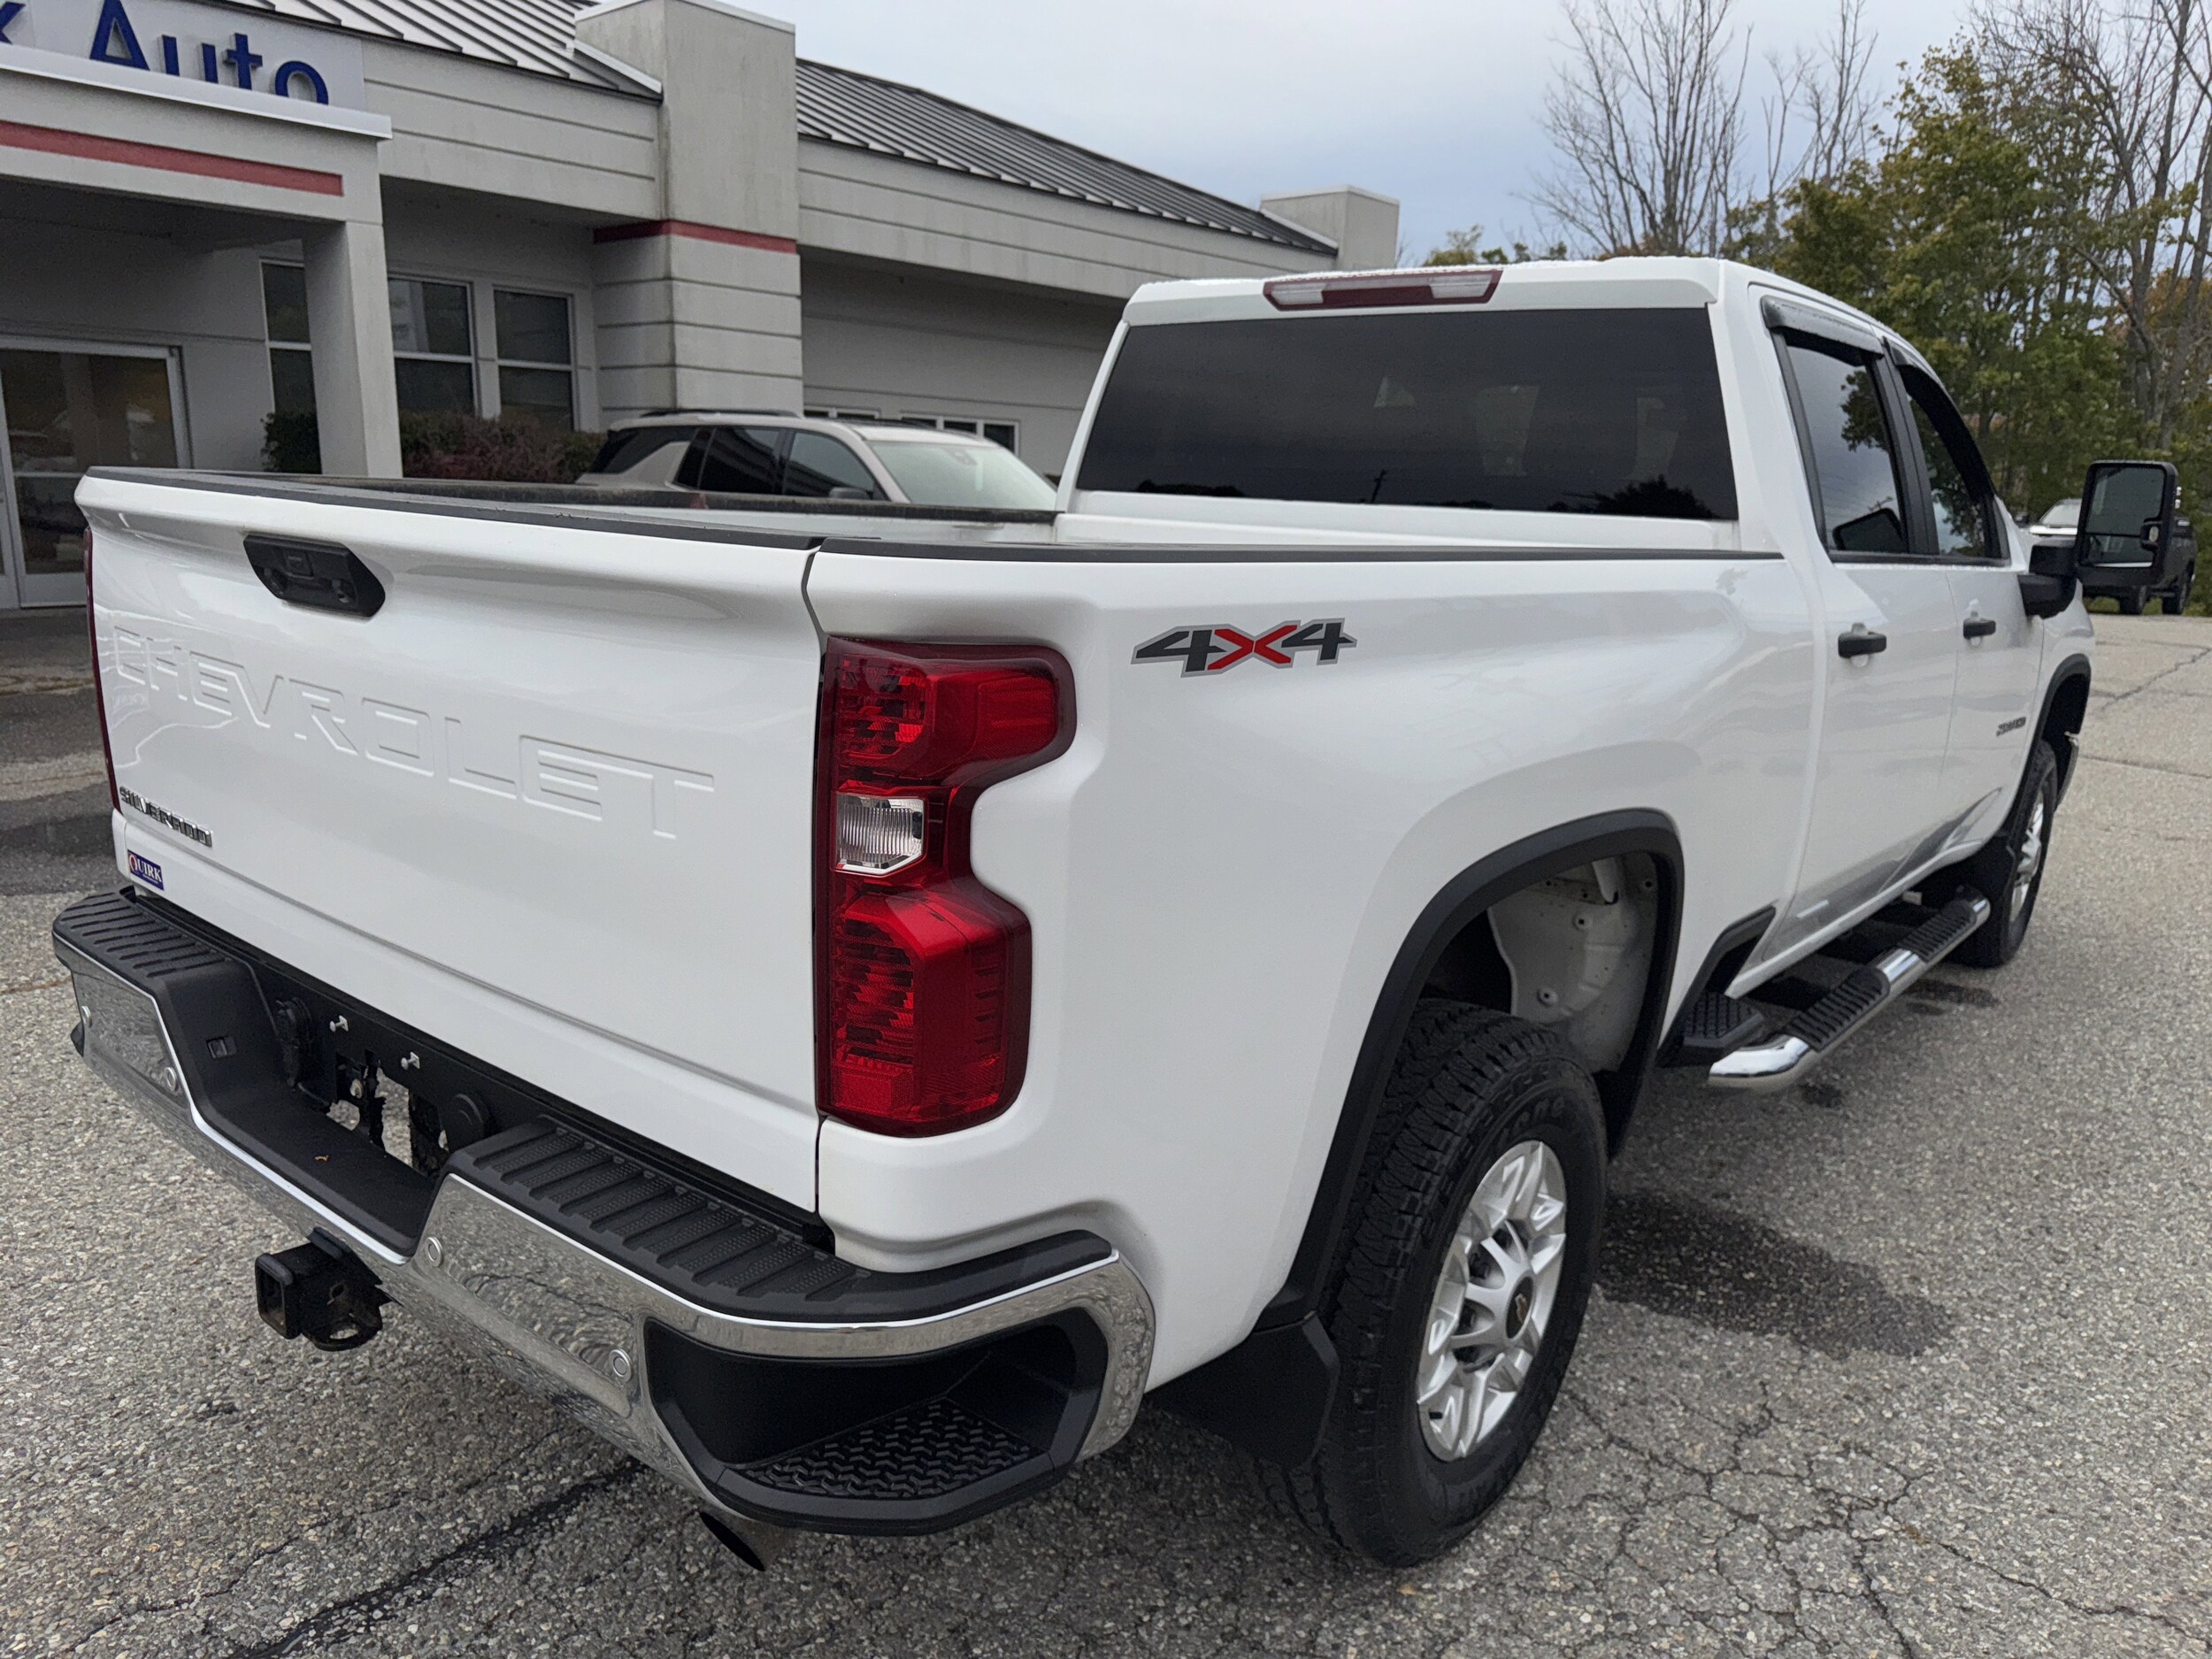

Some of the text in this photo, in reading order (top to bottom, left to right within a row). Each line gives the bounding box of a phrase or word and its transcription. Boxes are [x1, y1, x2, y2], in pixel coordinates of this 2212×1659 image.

[113, 626, 714, 840] CHEVROLET
[119, 787, 212, 848] SILVERADO
[128, 854, 163, 883] QUIRK
